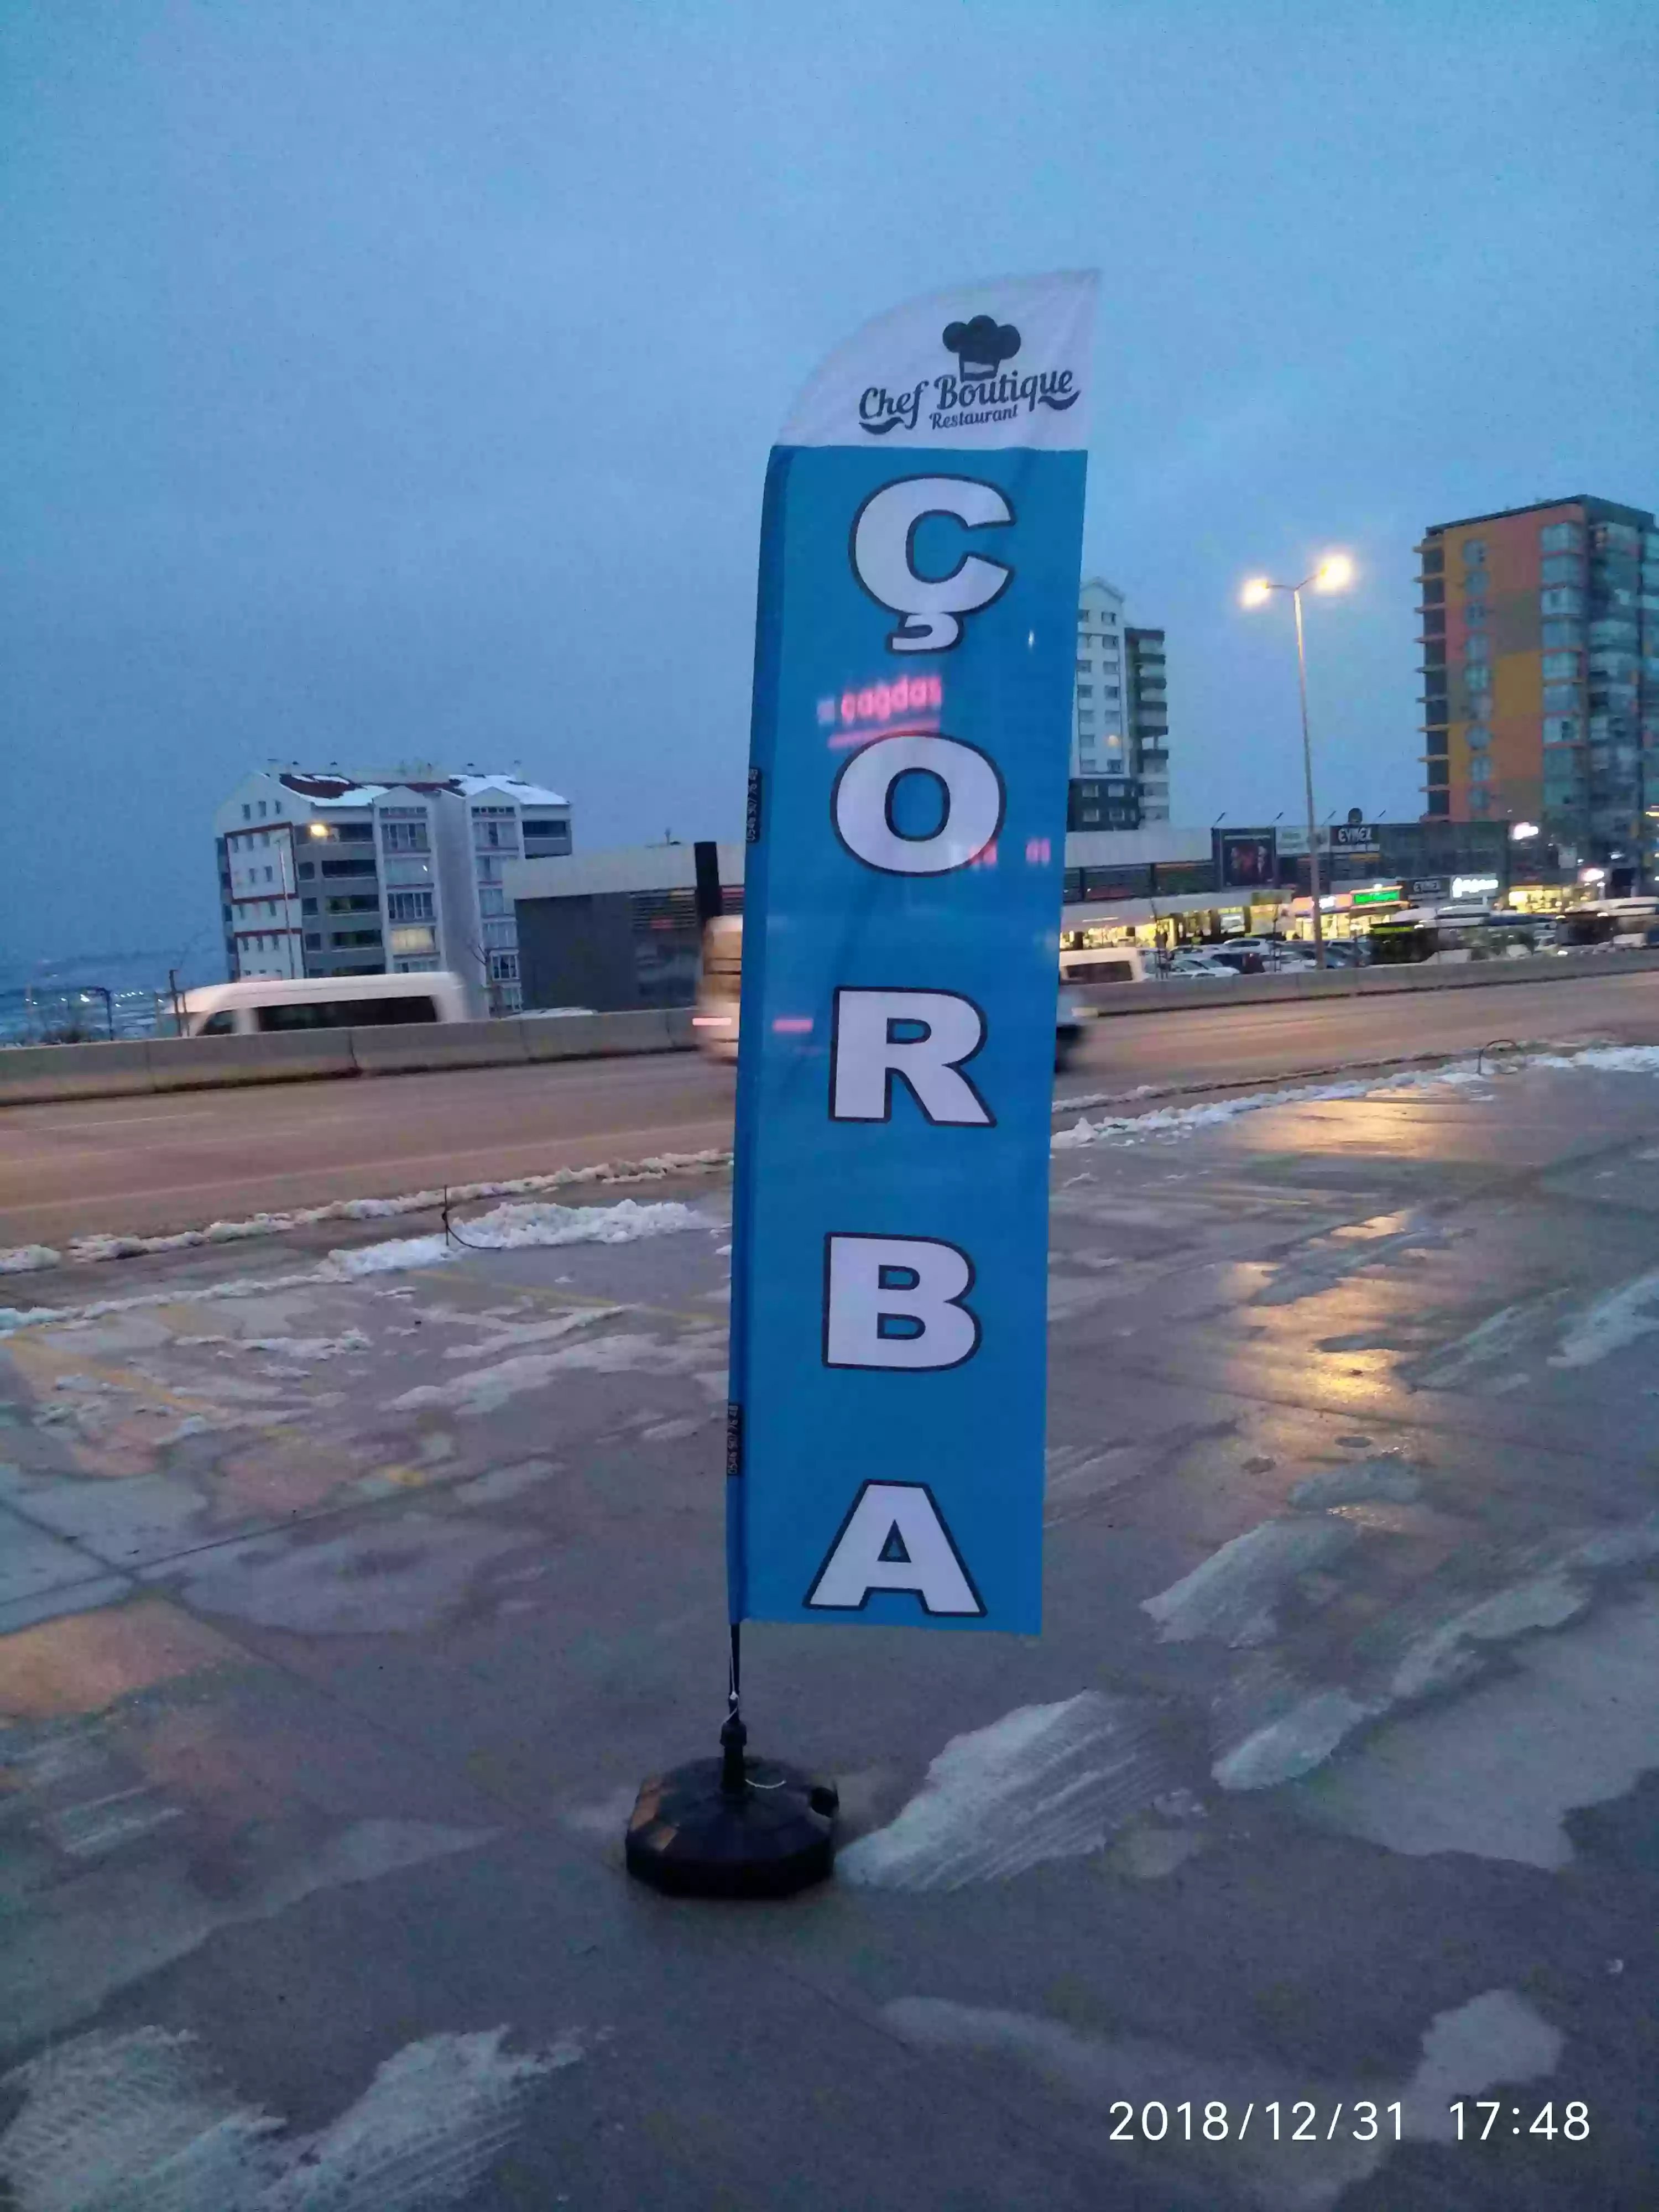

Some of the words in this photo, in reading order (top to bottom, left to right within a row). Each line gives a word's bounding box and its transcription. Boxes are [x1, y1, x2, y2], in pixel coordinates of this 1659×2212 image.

[858, 380, 930, 431] Chef
[933, 369, 1074, 412] Boutique
[928, 404, 1019, 430] Restaurant
[802, 473, 1016, 1618] ÇORBA
